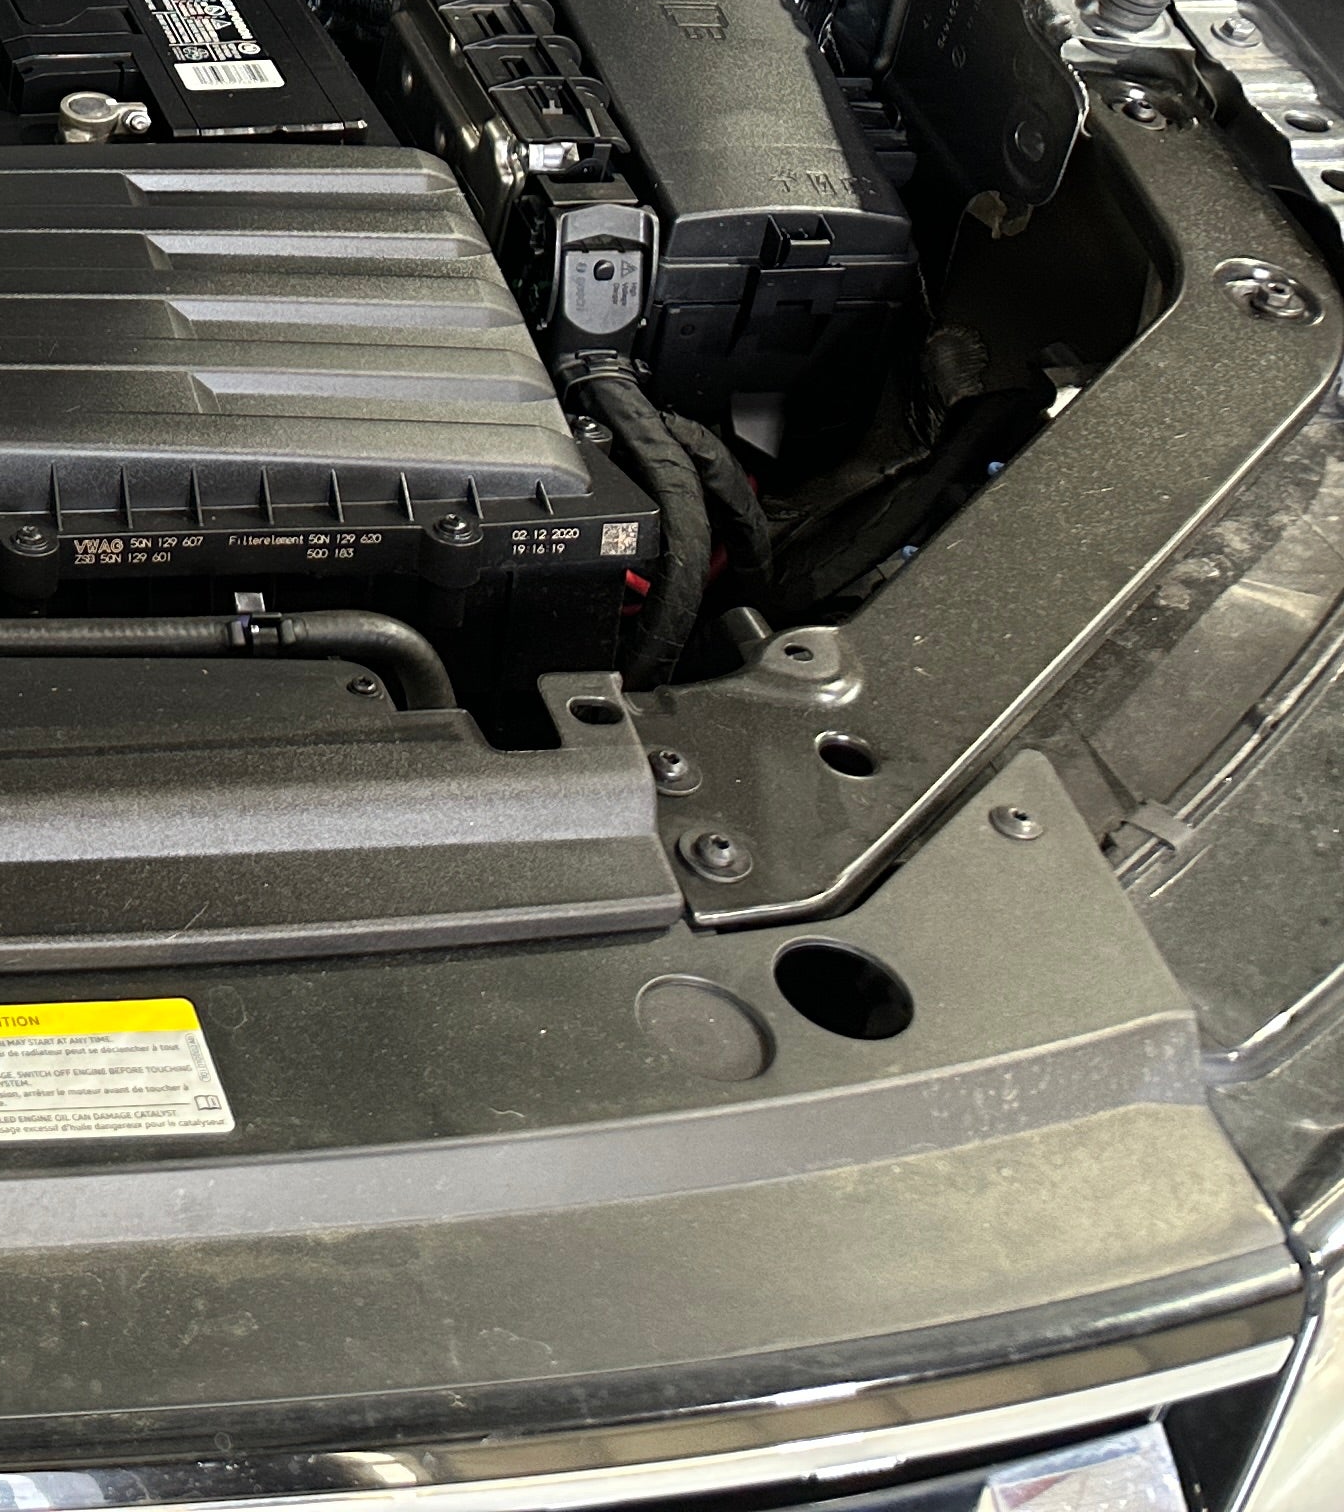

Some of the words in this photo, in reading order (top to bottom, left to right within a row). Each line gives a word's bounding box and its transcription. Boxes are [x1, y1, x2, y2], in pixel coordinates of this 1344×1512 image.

[158, 537, 177, 547] 129
[182, 536, 204, 547] 607
[229, 535, 304, 545] Filterelement
[336, 534, 356, 544] 129
[360, 533, 382, 544] 620
[128, 553, 147, 562] 129
[152, 552, 171, 562] 601
[335, 548, 354, 558] 183
[7, 1039, 26, 1047] MAY
